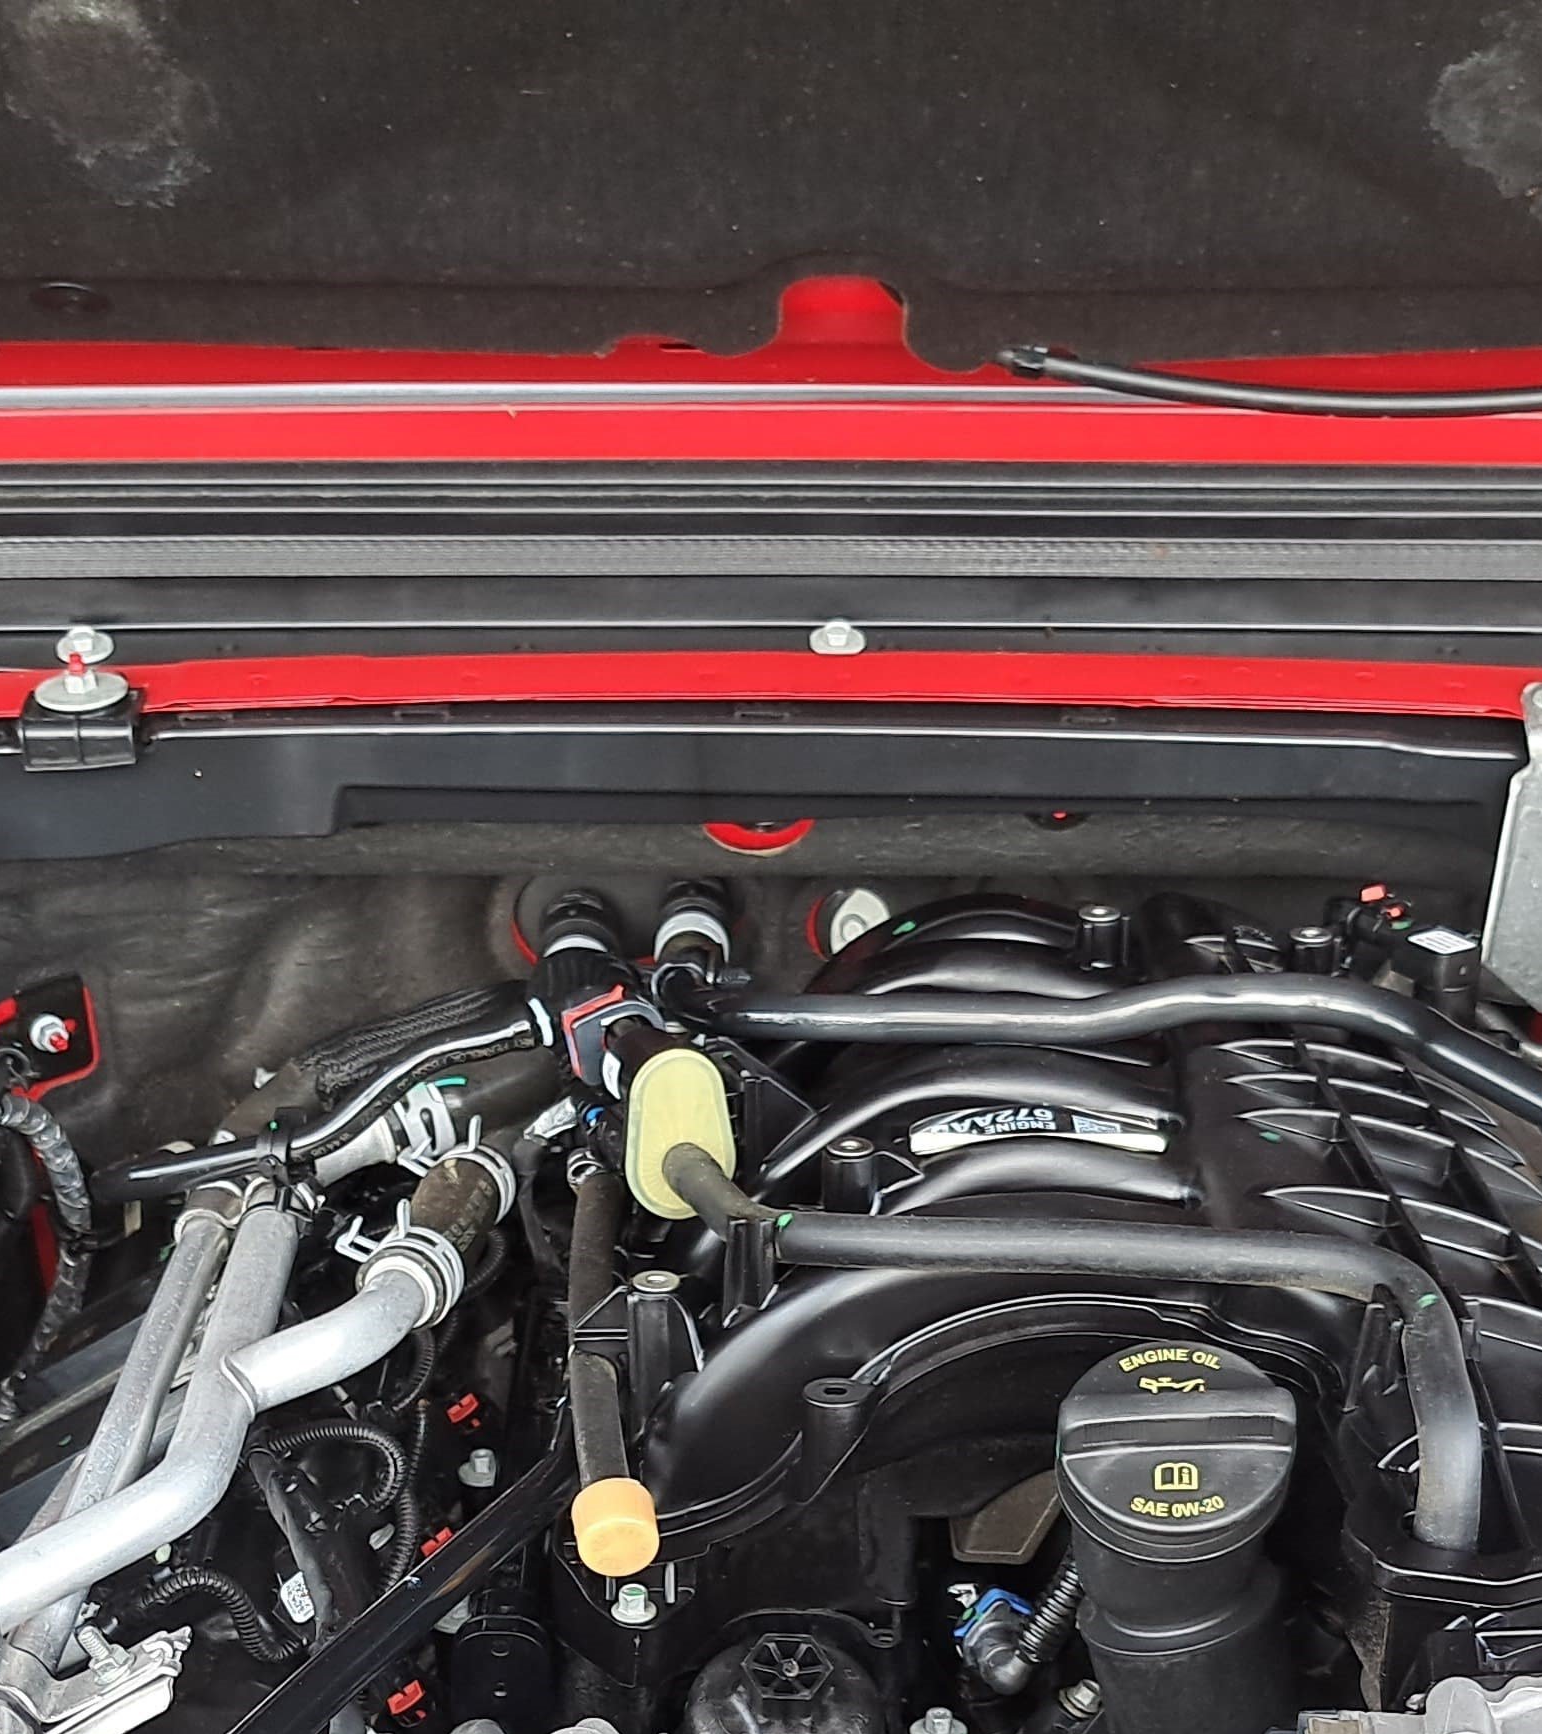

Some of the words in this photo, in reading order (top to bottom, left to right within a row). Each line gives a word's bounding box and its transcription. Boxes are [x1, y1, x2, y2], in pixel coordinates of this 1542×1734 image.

[984, 1119, 1056, 1136] ENGINE
[1118, 1348, 1189, 1372] ENGINE
[1192, 1350, 1221, 1370] OIL
[1130, 1496, 1168, 1517] SAE
[1171, 1495, 1225, 1518] 0W-20
